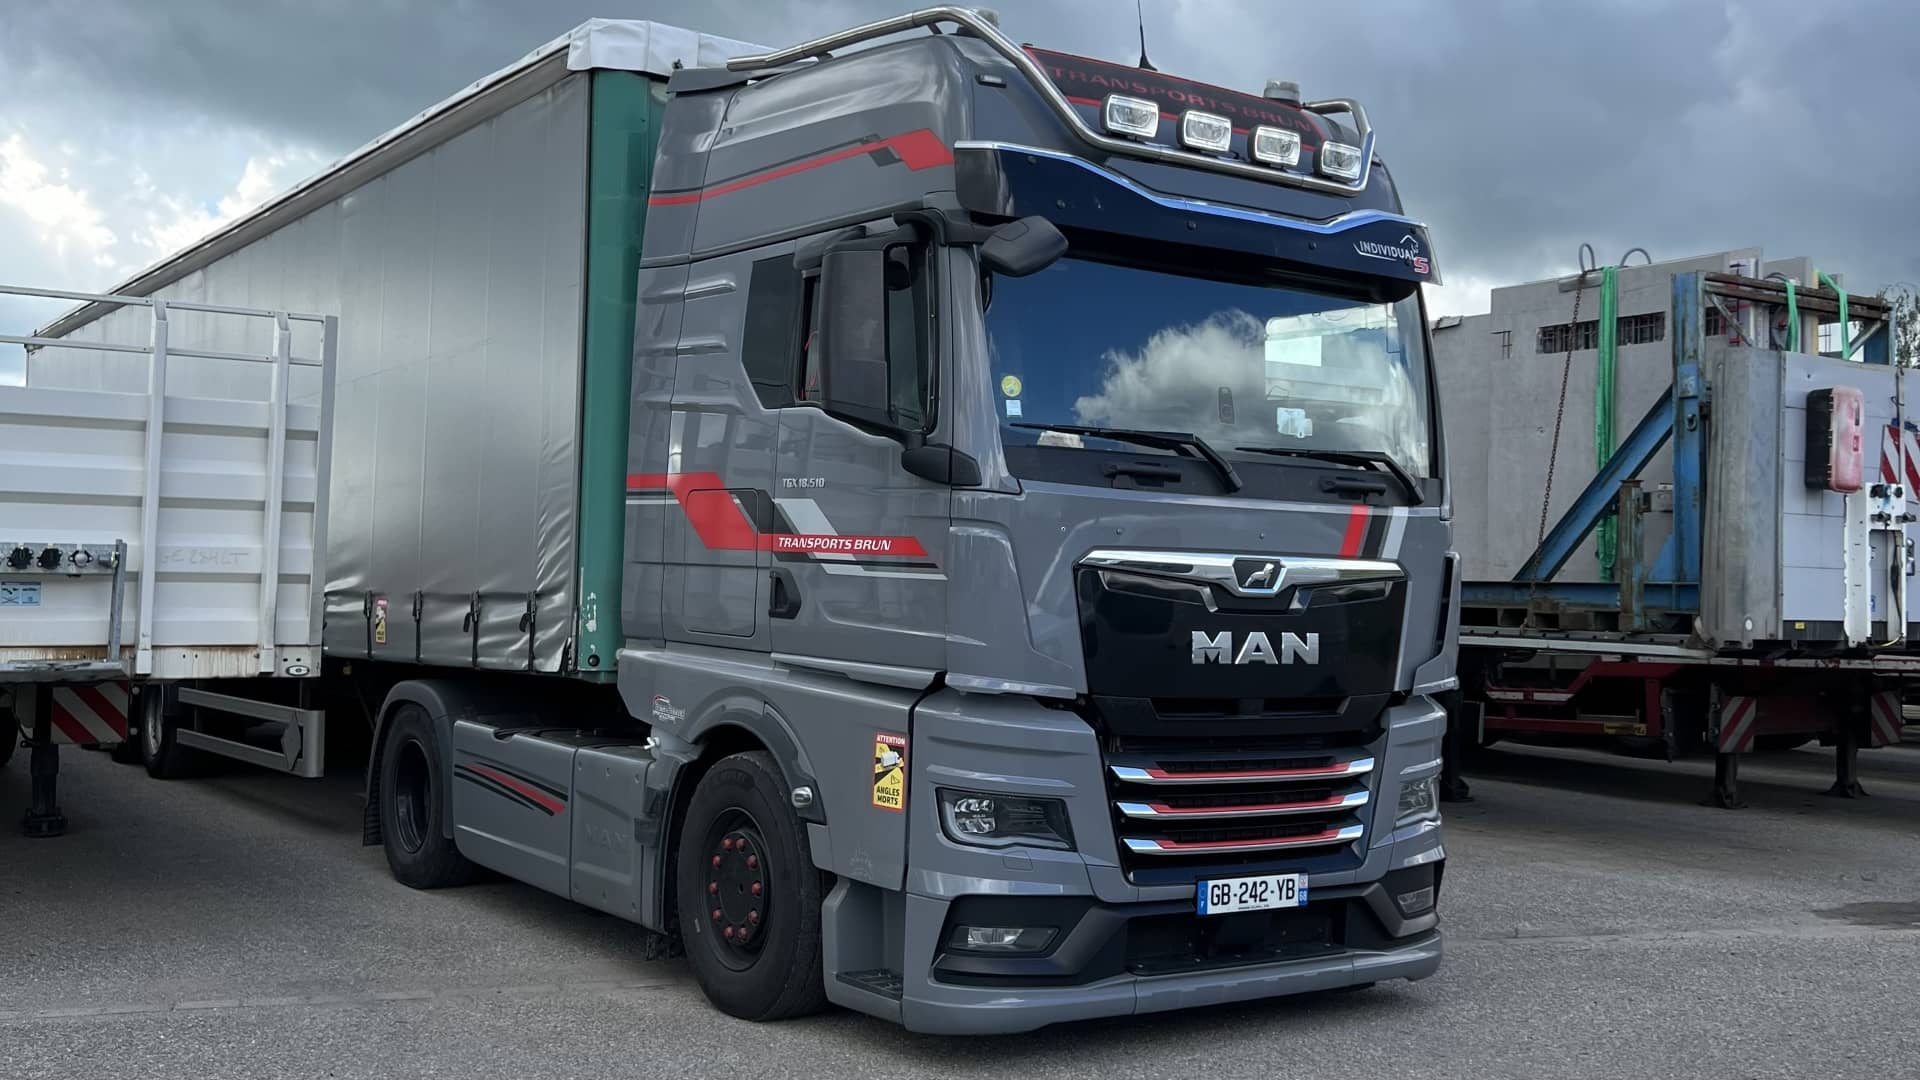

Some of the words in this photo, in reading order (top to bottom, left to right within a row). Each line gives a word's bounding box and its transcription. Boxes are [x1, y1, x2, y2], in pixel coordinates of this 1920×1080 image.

[1053, 67, 1236, 113] TRANSPORTS
[1240, 107, 1312, 132] BRUN
[1359, 240, 1415, 261] INDIVIDUAL
[1413, 256, 1429, 274] S
[782, 477, 798, 488] TGX
[798, 477, 825, 488] 18.510
[778, 536, 853, 550] TRANSPORTS
[854, 538, 891, 551] BRUN
[1191, 630, 1319, 665] MAN
[876, 733, 906, 745] ATTENTION
[876, 785, 900, 797] ANGLES
[877, 794, 898, 806] MORTS
[1210, 878, 1296, 906] GB-242-YB
